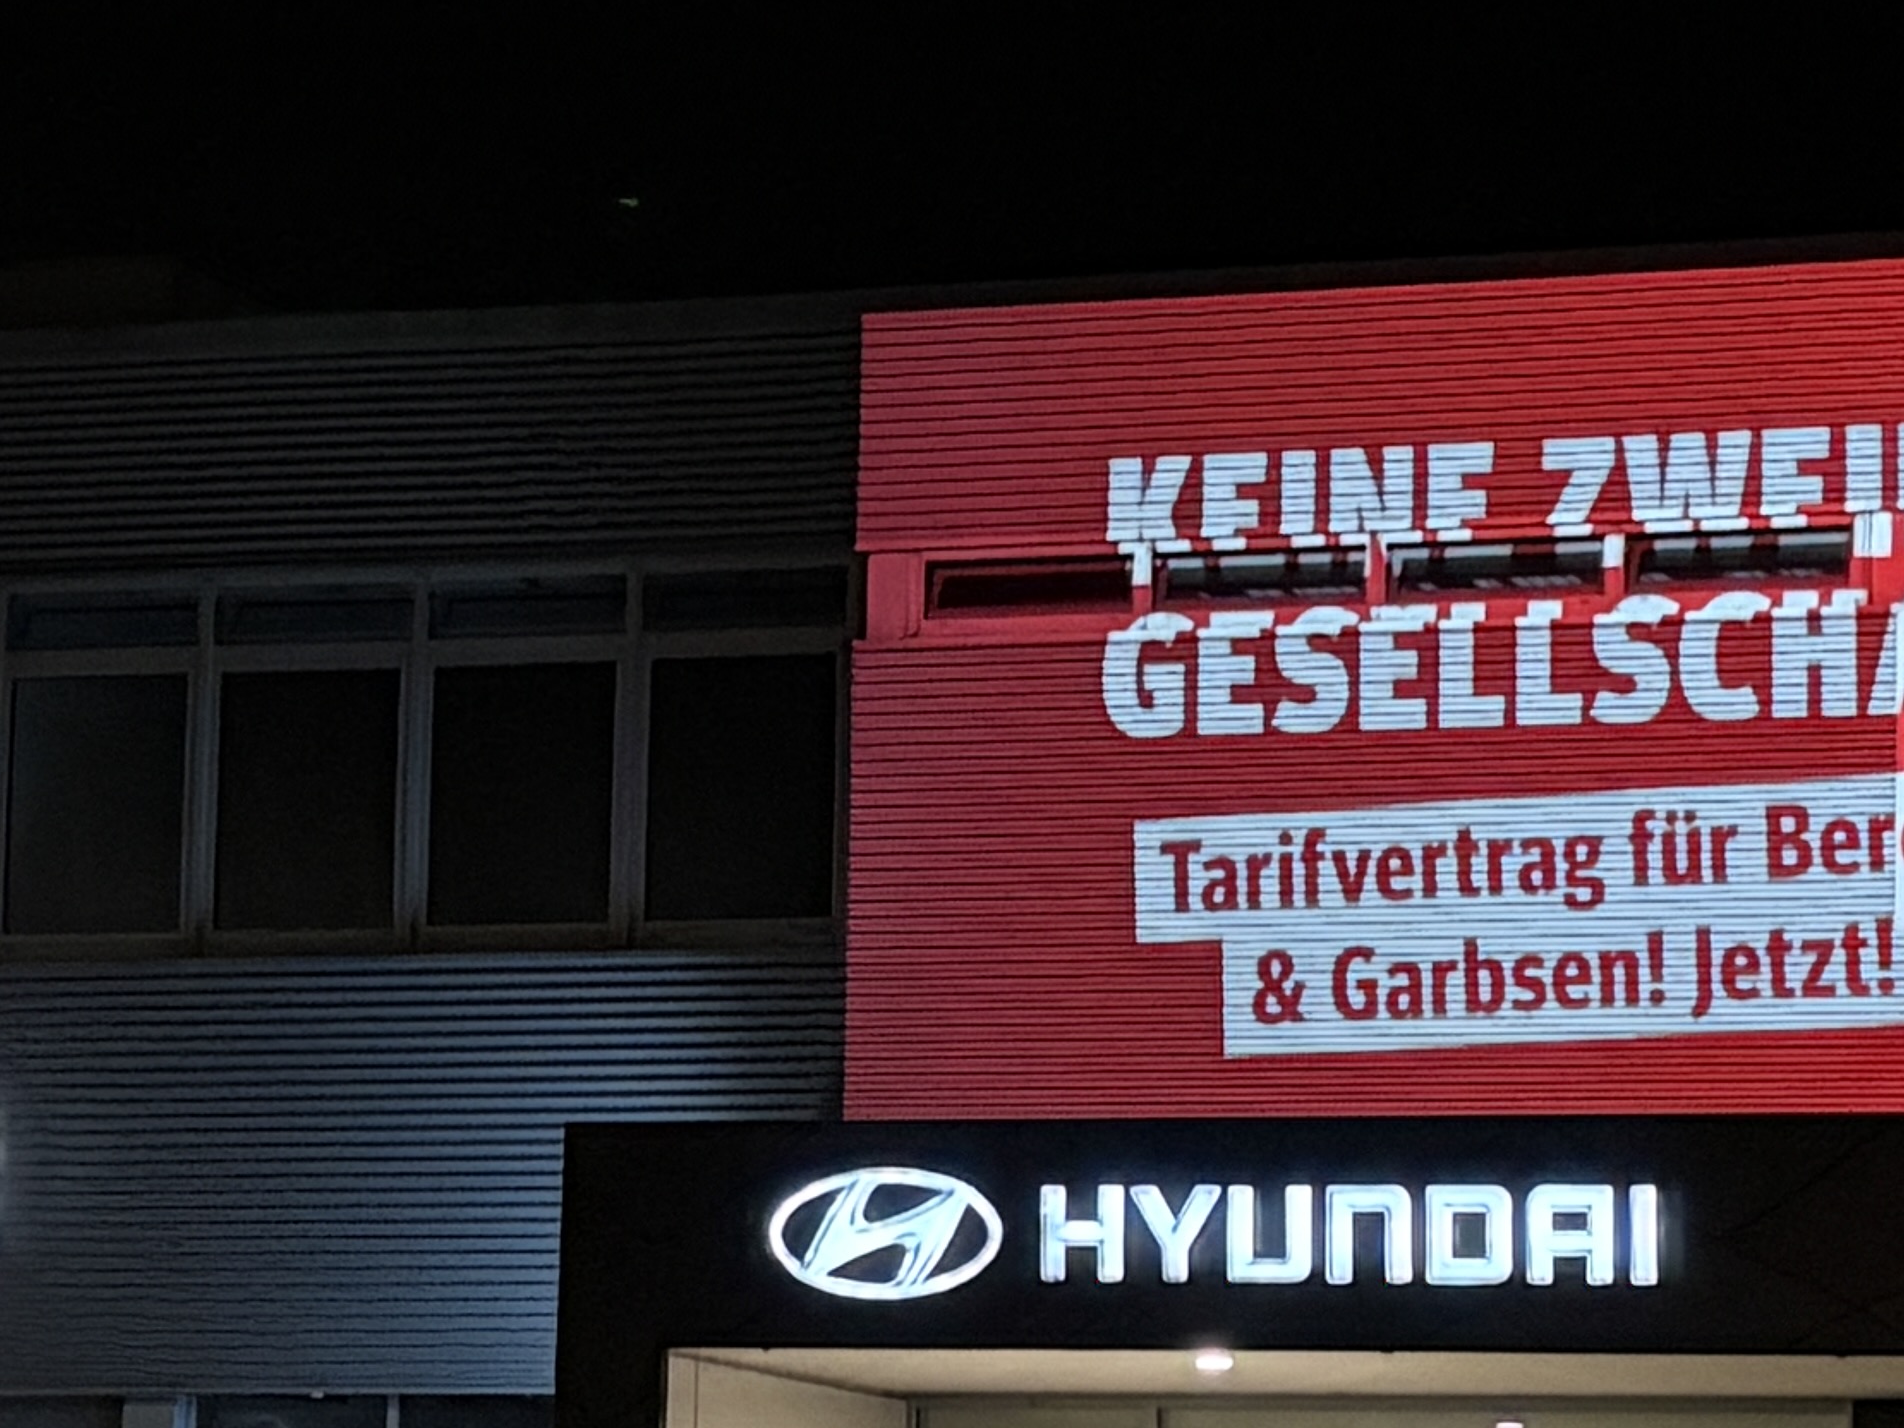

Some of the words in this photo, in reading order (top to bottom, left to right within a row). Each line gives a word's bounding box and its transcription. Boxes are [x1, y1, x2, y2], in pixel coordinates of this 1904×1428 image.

[1104, 440, 1495, 560] KEINE
[1158, 824, 1606, 913] Tarifvertrag
[1629, 808, 1739, 888] für
[1251, 947, 1307, 1025] &
[1330, 930, 1667, 1022] Garbsen!
[1692, 914, 1897, 1018] Jetzt!
[1039, 1183, 1659, 1287] HYUNDAI
